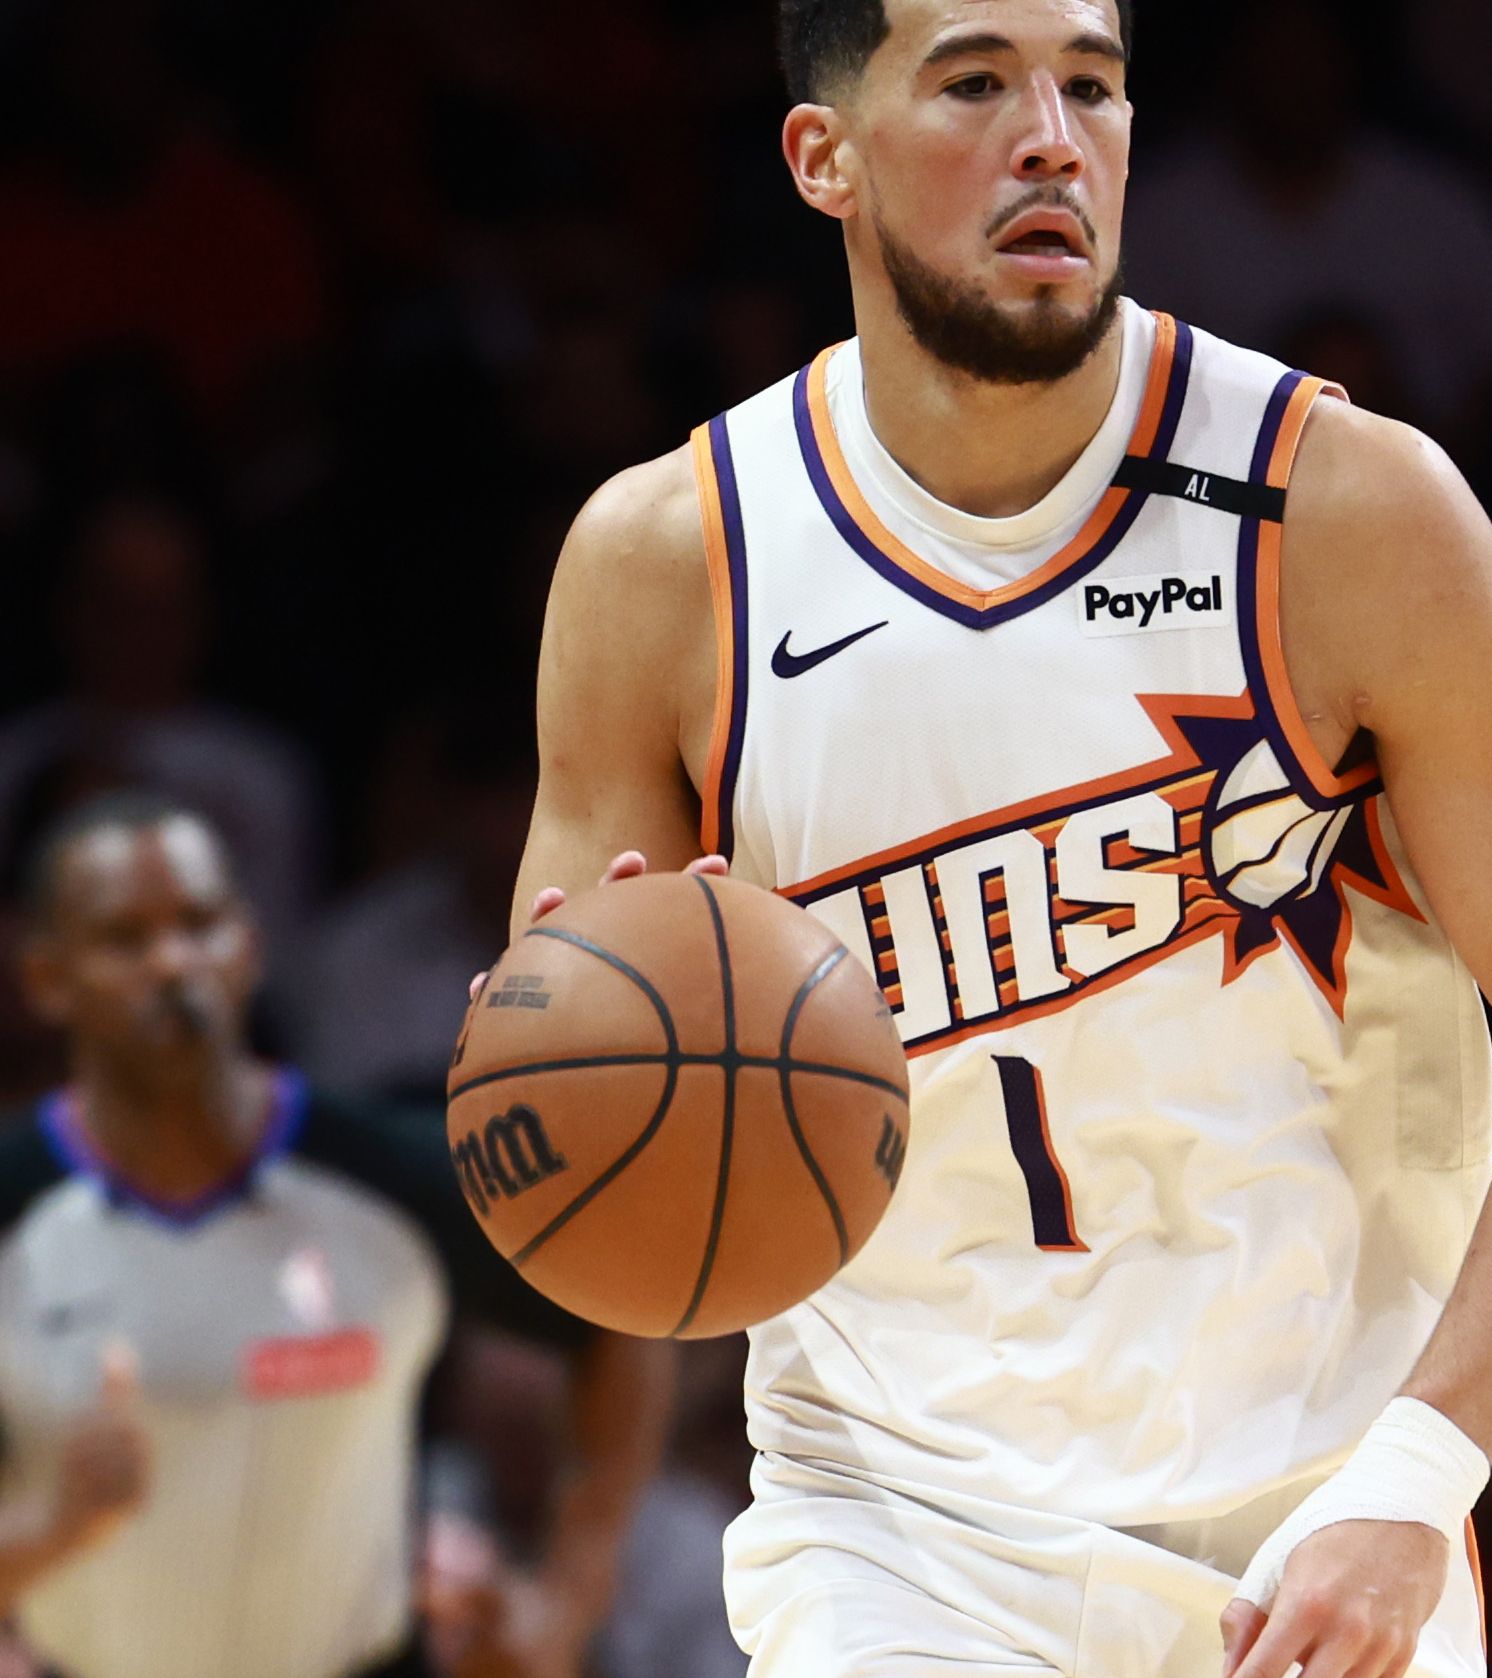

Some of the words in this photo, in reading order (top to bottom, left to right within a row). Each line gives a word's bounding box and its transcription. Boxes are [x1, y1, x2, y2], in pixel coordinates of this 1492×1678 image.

[1184, 474, 1210, 501] AL
[1084, 575, 1222, 627] PayPal
[802, 790, 1184, 1044] UNS
[990, 1054, 1091, 1253] 1
